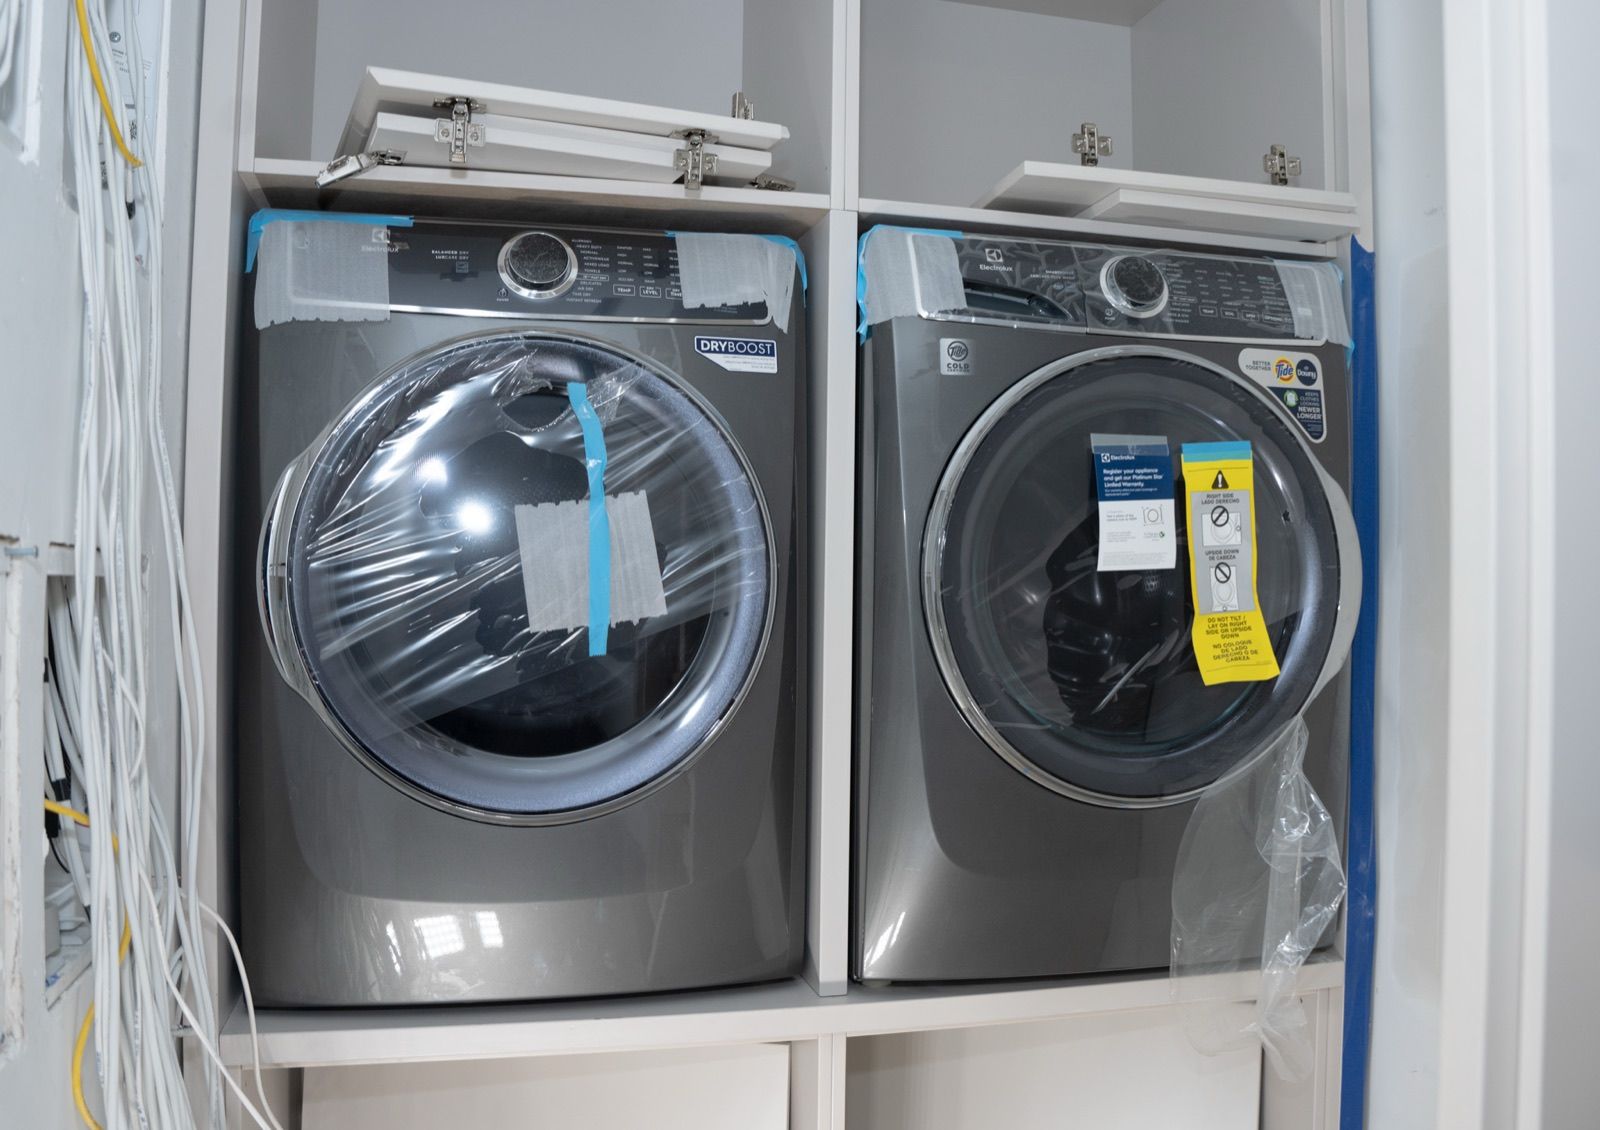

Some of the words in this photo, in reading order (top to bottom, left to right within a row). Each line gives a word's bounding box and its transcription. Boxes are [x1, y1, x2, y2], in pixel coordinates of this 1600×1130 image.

[980, 264, 1013, 272] Electrolux
[701, 340, 772, 355] DRYBOOST
[1276, 364, 1294, 378] Tide
[1298, 370, 1316, 380] Downy
[1223, 640, 1252, 648] COLOQUE
[1213, 651, 1242, 659] DERECHO
